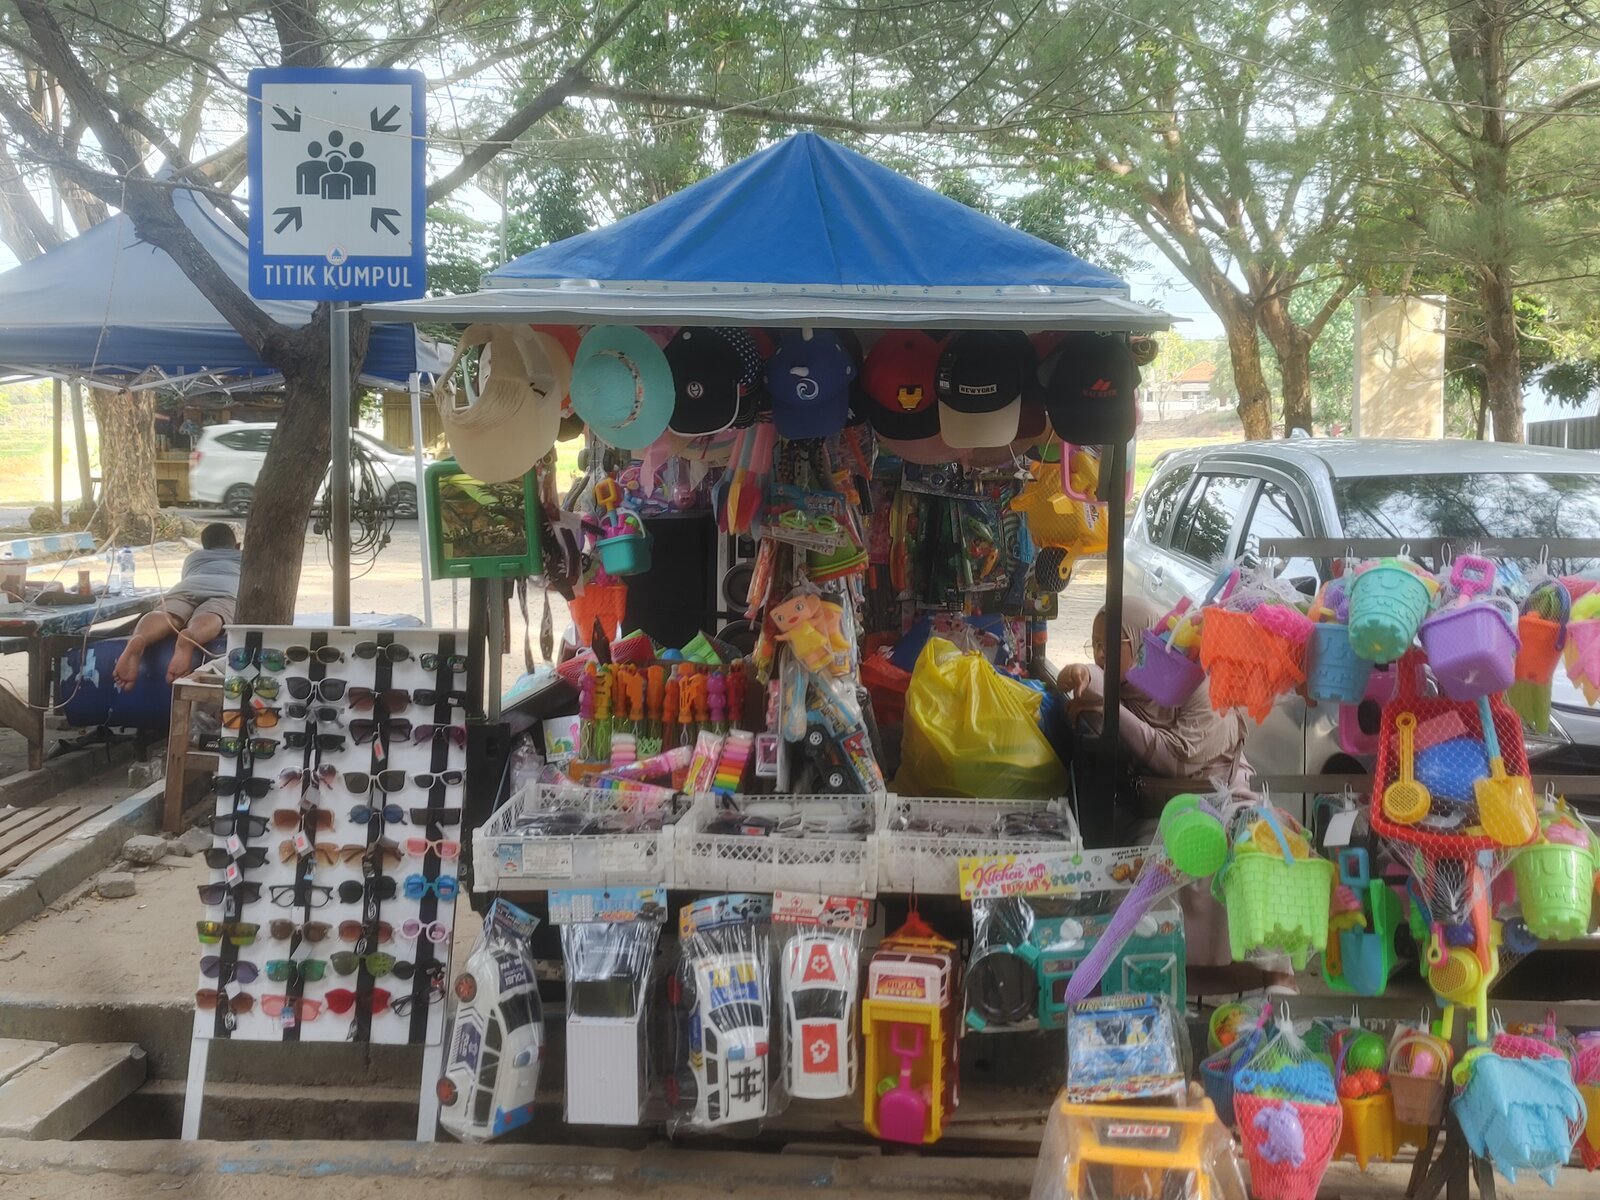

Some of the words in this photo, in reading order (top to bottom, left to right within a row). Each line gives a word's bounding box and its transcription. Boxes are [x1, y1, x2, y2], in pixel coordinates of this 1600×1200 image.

[263, 265, 316, 286] TITIK
[323, 266, 412, 287] KUMPUL
[973, 863, 1024, 888] Kitchen
